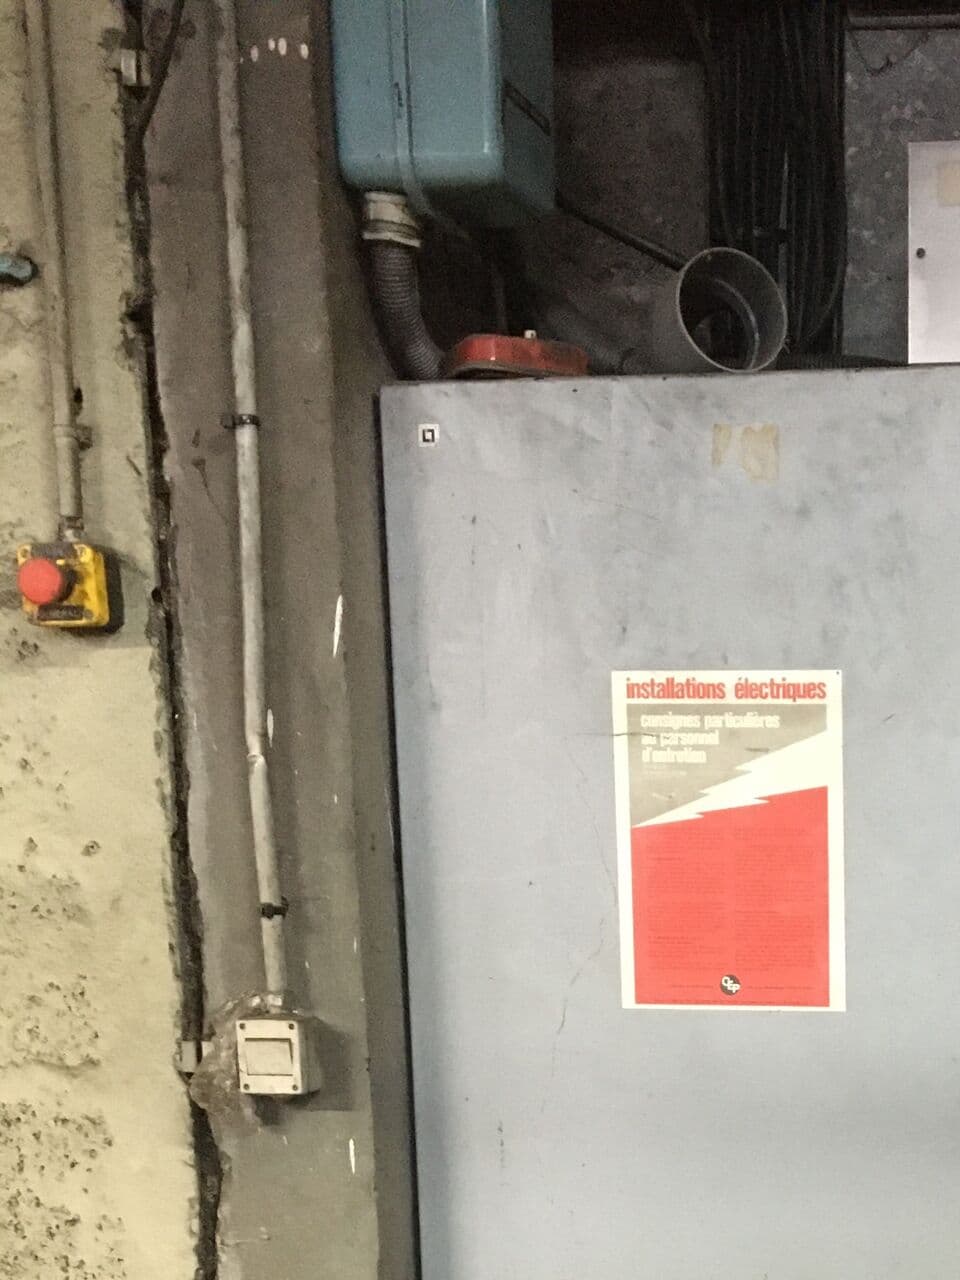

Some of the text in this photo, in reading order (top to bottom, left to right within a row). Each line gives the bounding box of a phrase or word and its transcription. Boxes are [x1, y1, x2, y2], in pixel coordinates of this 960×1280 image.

[626, 677, 827, 702] installations électriques
[640, 711, 780, 730] consignes particulières
[660, 730, 719, 747] personnel
[641, 747, 707, 763] d'entretien
